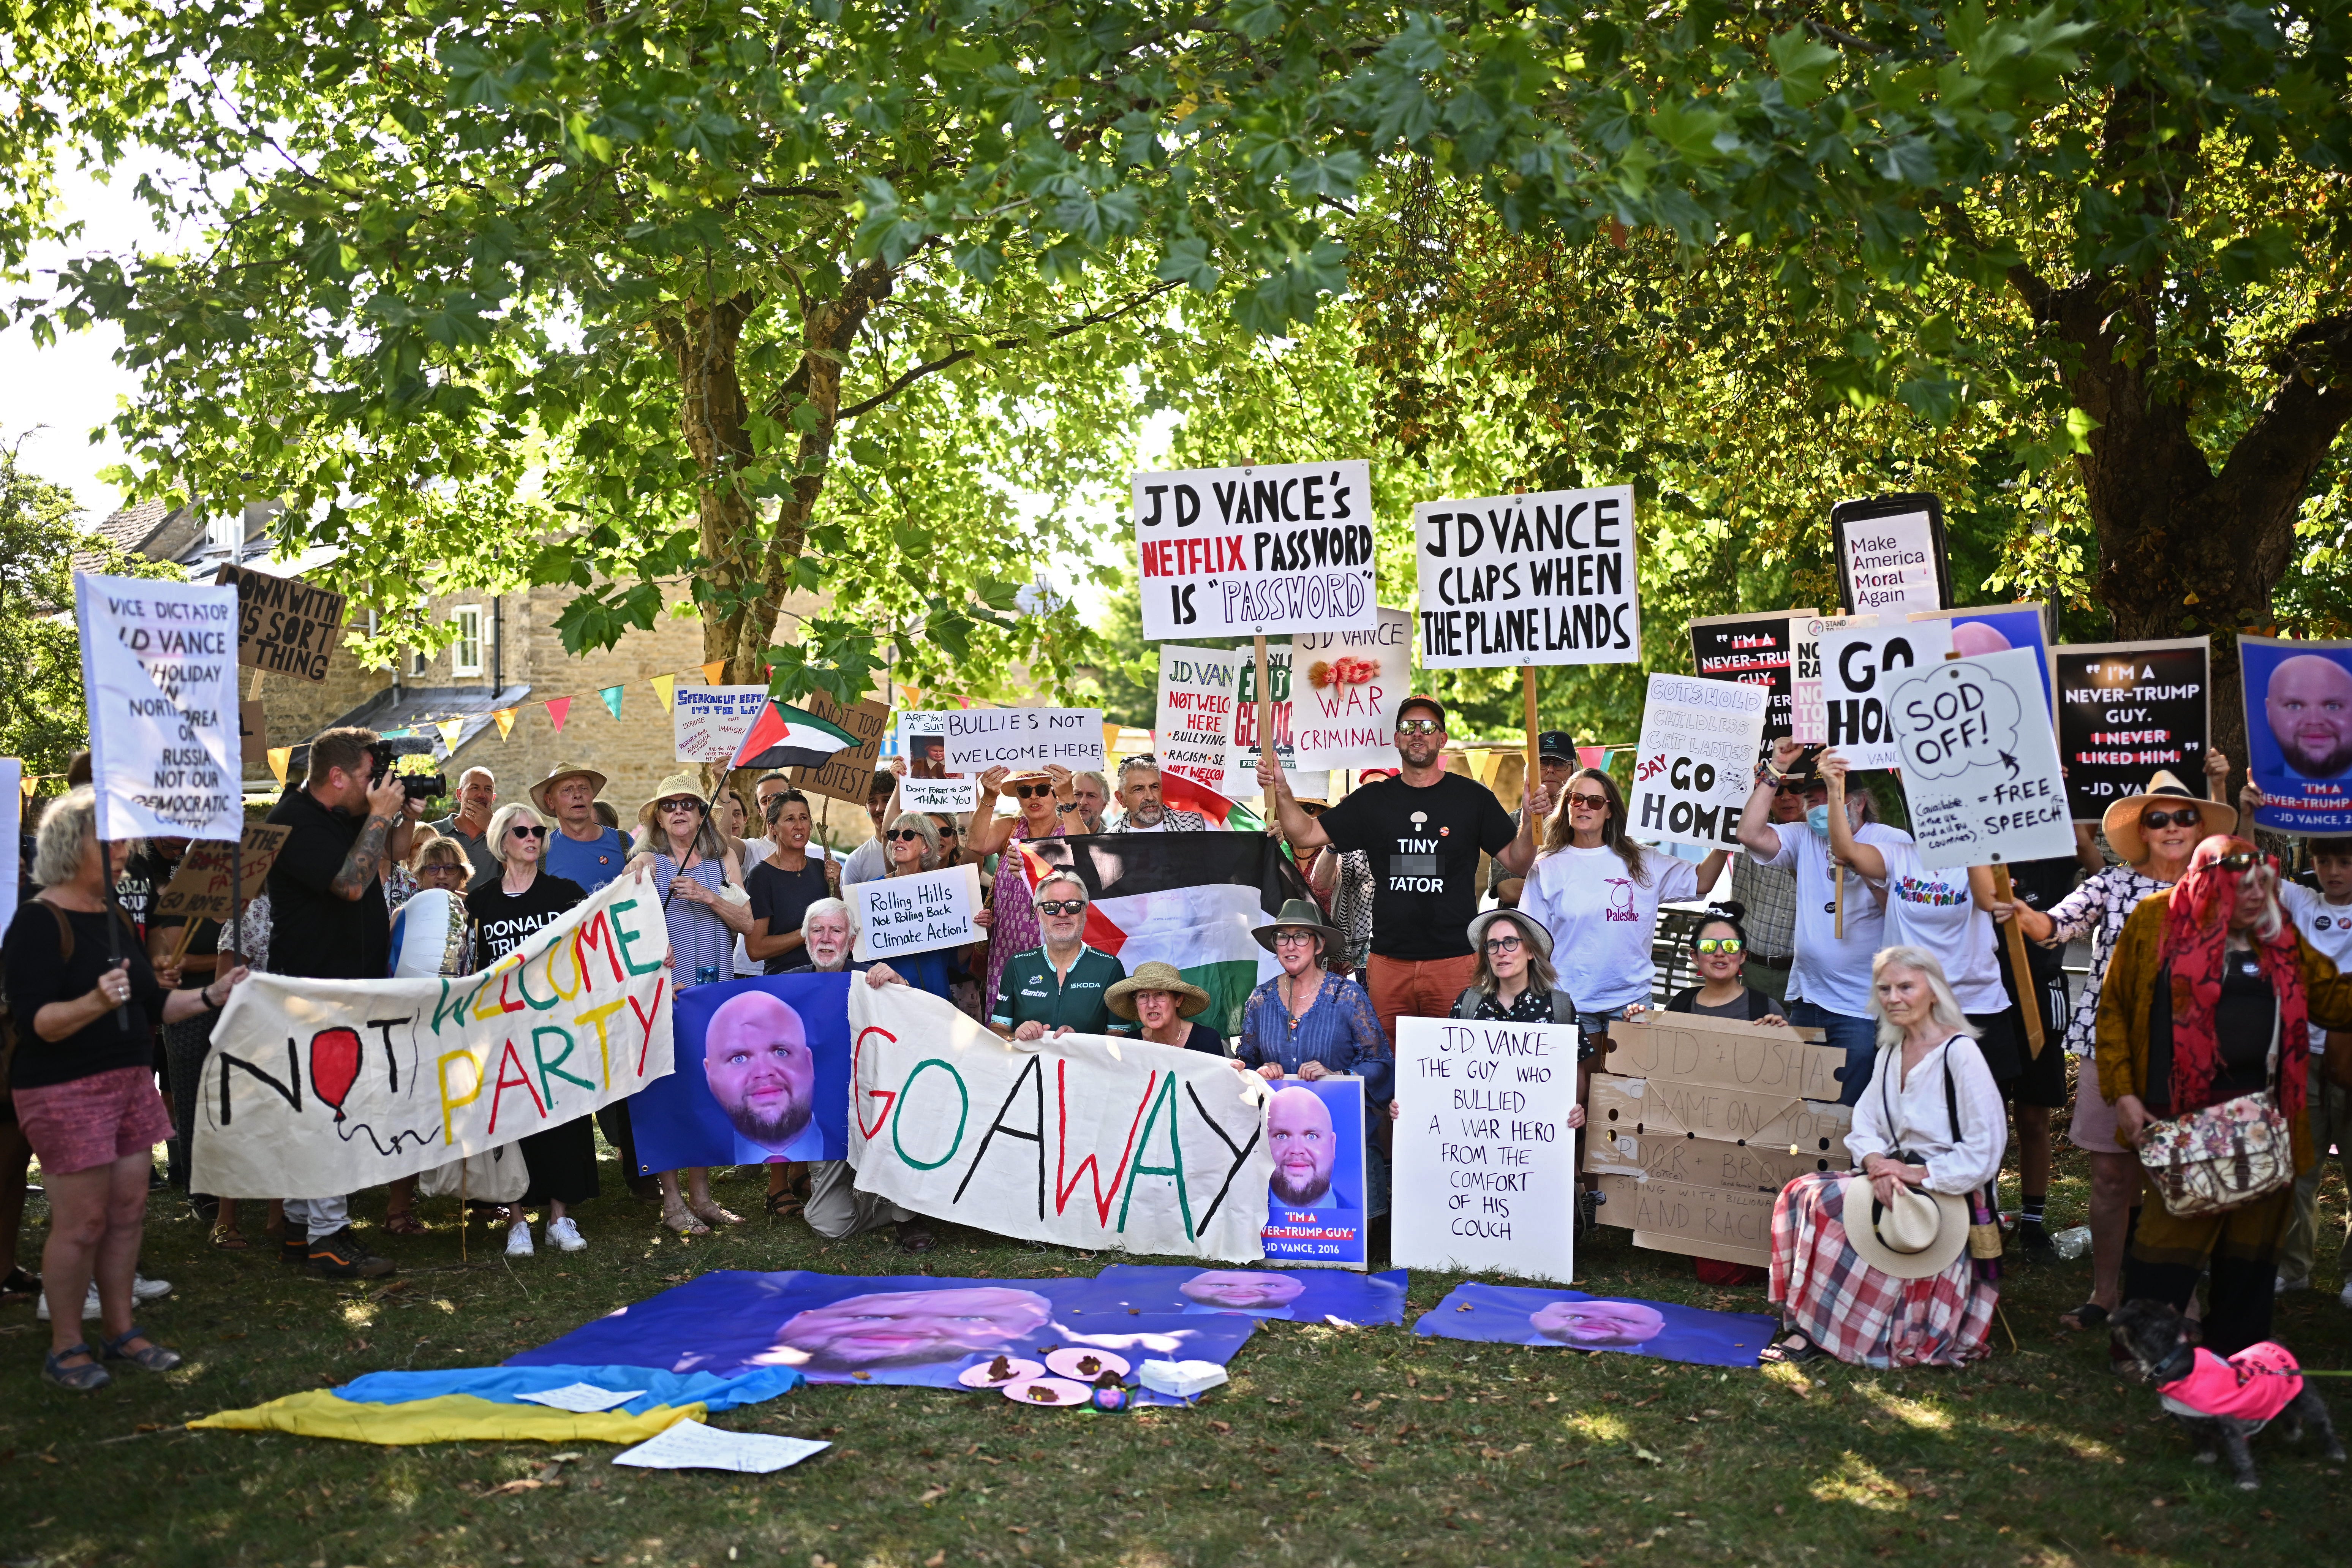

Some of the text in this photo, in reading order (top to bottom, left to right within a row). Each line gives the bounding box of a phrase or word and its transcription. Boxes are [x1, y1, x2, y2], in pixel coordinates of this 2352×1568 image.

[1142, 484, 1200, 527] JD
[1426, 498, 1620, 557] JD VANCE
[1142, 525, 1372, 577] NETFLIX PASSWORD
[1851, 537, 1896, 553] Make
[1854, 551, 1925, 570] America
[1438, 552, 1622, 605] CLAPS WHEN
[1855, 571, 1905, 589] Moral
[109, 597, 228, 620] VICE DICTATOR
[289, 584, 341, 624] WITH
[1171, 570, 1373, 624] IS "PASSWORD"
[1858, 589, 1905, 607] Again
[266, 611, 335, 653] SORT
[1421, 602, 1630, 656] THE PLANE LANDS
[1762, 632, 1774, 646] A
[158, 630, 225, 654] VANCE
[256, 638, 328, 680] THING
[151, 664, 221, 682] HOLIDAY
[2141, 665, 2156, 679] A
[724, 695, 736, 704] UP
[1169, 691, 1195, 710] NOT
[1316, 686, 1383, 719] WAR
[1651, 680, 1761, 711] COTSWOLD
[2065, 684, 2200, 703] NEVER-TRUMP
[692, 705, 733, 715] IT'S TOO
[905, 713, 926, 722] ARE
[1906, 683, 1984, 732] SOD
[2105, 708, 2152, 723] GUY.
[683, 716, 705, 730] UKRAINE
[857, 712, 882, 738] TOO
[1050, 715, 1085, 729] NOT
[1187, 713, 1222, 733] HERE
[1653, 710, 1750, 736] CHILDLESS
[679, 729, 708, 749] RESEARCH AND
[687, 733, 712, 754] ACADEMIA
[697, 741, 708, 751] SCIENCE
[1172, 730, 1227, 746] BULLYING
[1301, 727, 1392, 751] CRIMINAL
[1646, 730, 1686, 749] CAT
[1690, 737, 1754, 761] LADIES
[1916, 710, 1989, 764] OFF!
[2094, 729, 2166, 745] I NEVER
[163, 748, 212, 766] RUSSIA
[952, 743, 1103, 765] WELCOME HERE!
[1168, 749, 1208, 764] RACISM
[2082, 749, 2180, 764] LIKED HIM.
[154, 771, 219, 788] NOT OUR
[1637, 753, 1715, 792] SAY GO
[906, 784, 925, 792] DON'T
[1994, 778, 2051, 805] FREE
[2330, 783, 2341, 793] A
[914, 795, 971, 805] THANK YOU
[1641, 792, 1743, 845] HOME
[1984, 806, 2062, 835] SPEECH
[1397, 839, 1438, 853] TINY
[115, 880, 148, 894] GAZA
[1389, 877, 1443, 893] TATOR
[160, 892, 184, 909] GO
[185, 895, 226, 912] HOME
[870, 882, 952, 912] Rolling Hills
[483, 912, 561, 940] DONALD
[872, 904, 952, 927] Not Rolling Back
[873, 916, 968, 949] Climate Action!
[432, 898, 662, 1035] WELCOME
[1021, 989, 1048, 998] Santini
[438, 976, 665, 1145] PARTY
[1417, 1057, 1551, 1083] THE GUY WHO
[1631, 1027, 1825, 1092] JD USHA
[1454, 1089, 1525, 1114] BULLIED
[1625, 1084, 1838, 1140] SHAME ON YOU
[854, 1026, 1265, 1243] GO AWAY
[1429, 1114, 1555, 1142] A WAR HERO
[1442, 1143, 1532, 1167] FROM THE
[1618, 1139, 1689, 1174] POOR
[1450, 1171, 1536, 1191] COMFORT
[1617, 1179, 1716, 1201] SIDING WITH
[1308, 1212, 1316, 1222] A
[1449, 1194, 1510, 1218] OF HIS
[1636, 1197, 1689, 1228] AND
[1452, 1218, 1511, 1241] COUCH
[1280, 1244, 1340, 1254] VANCE, 2016
